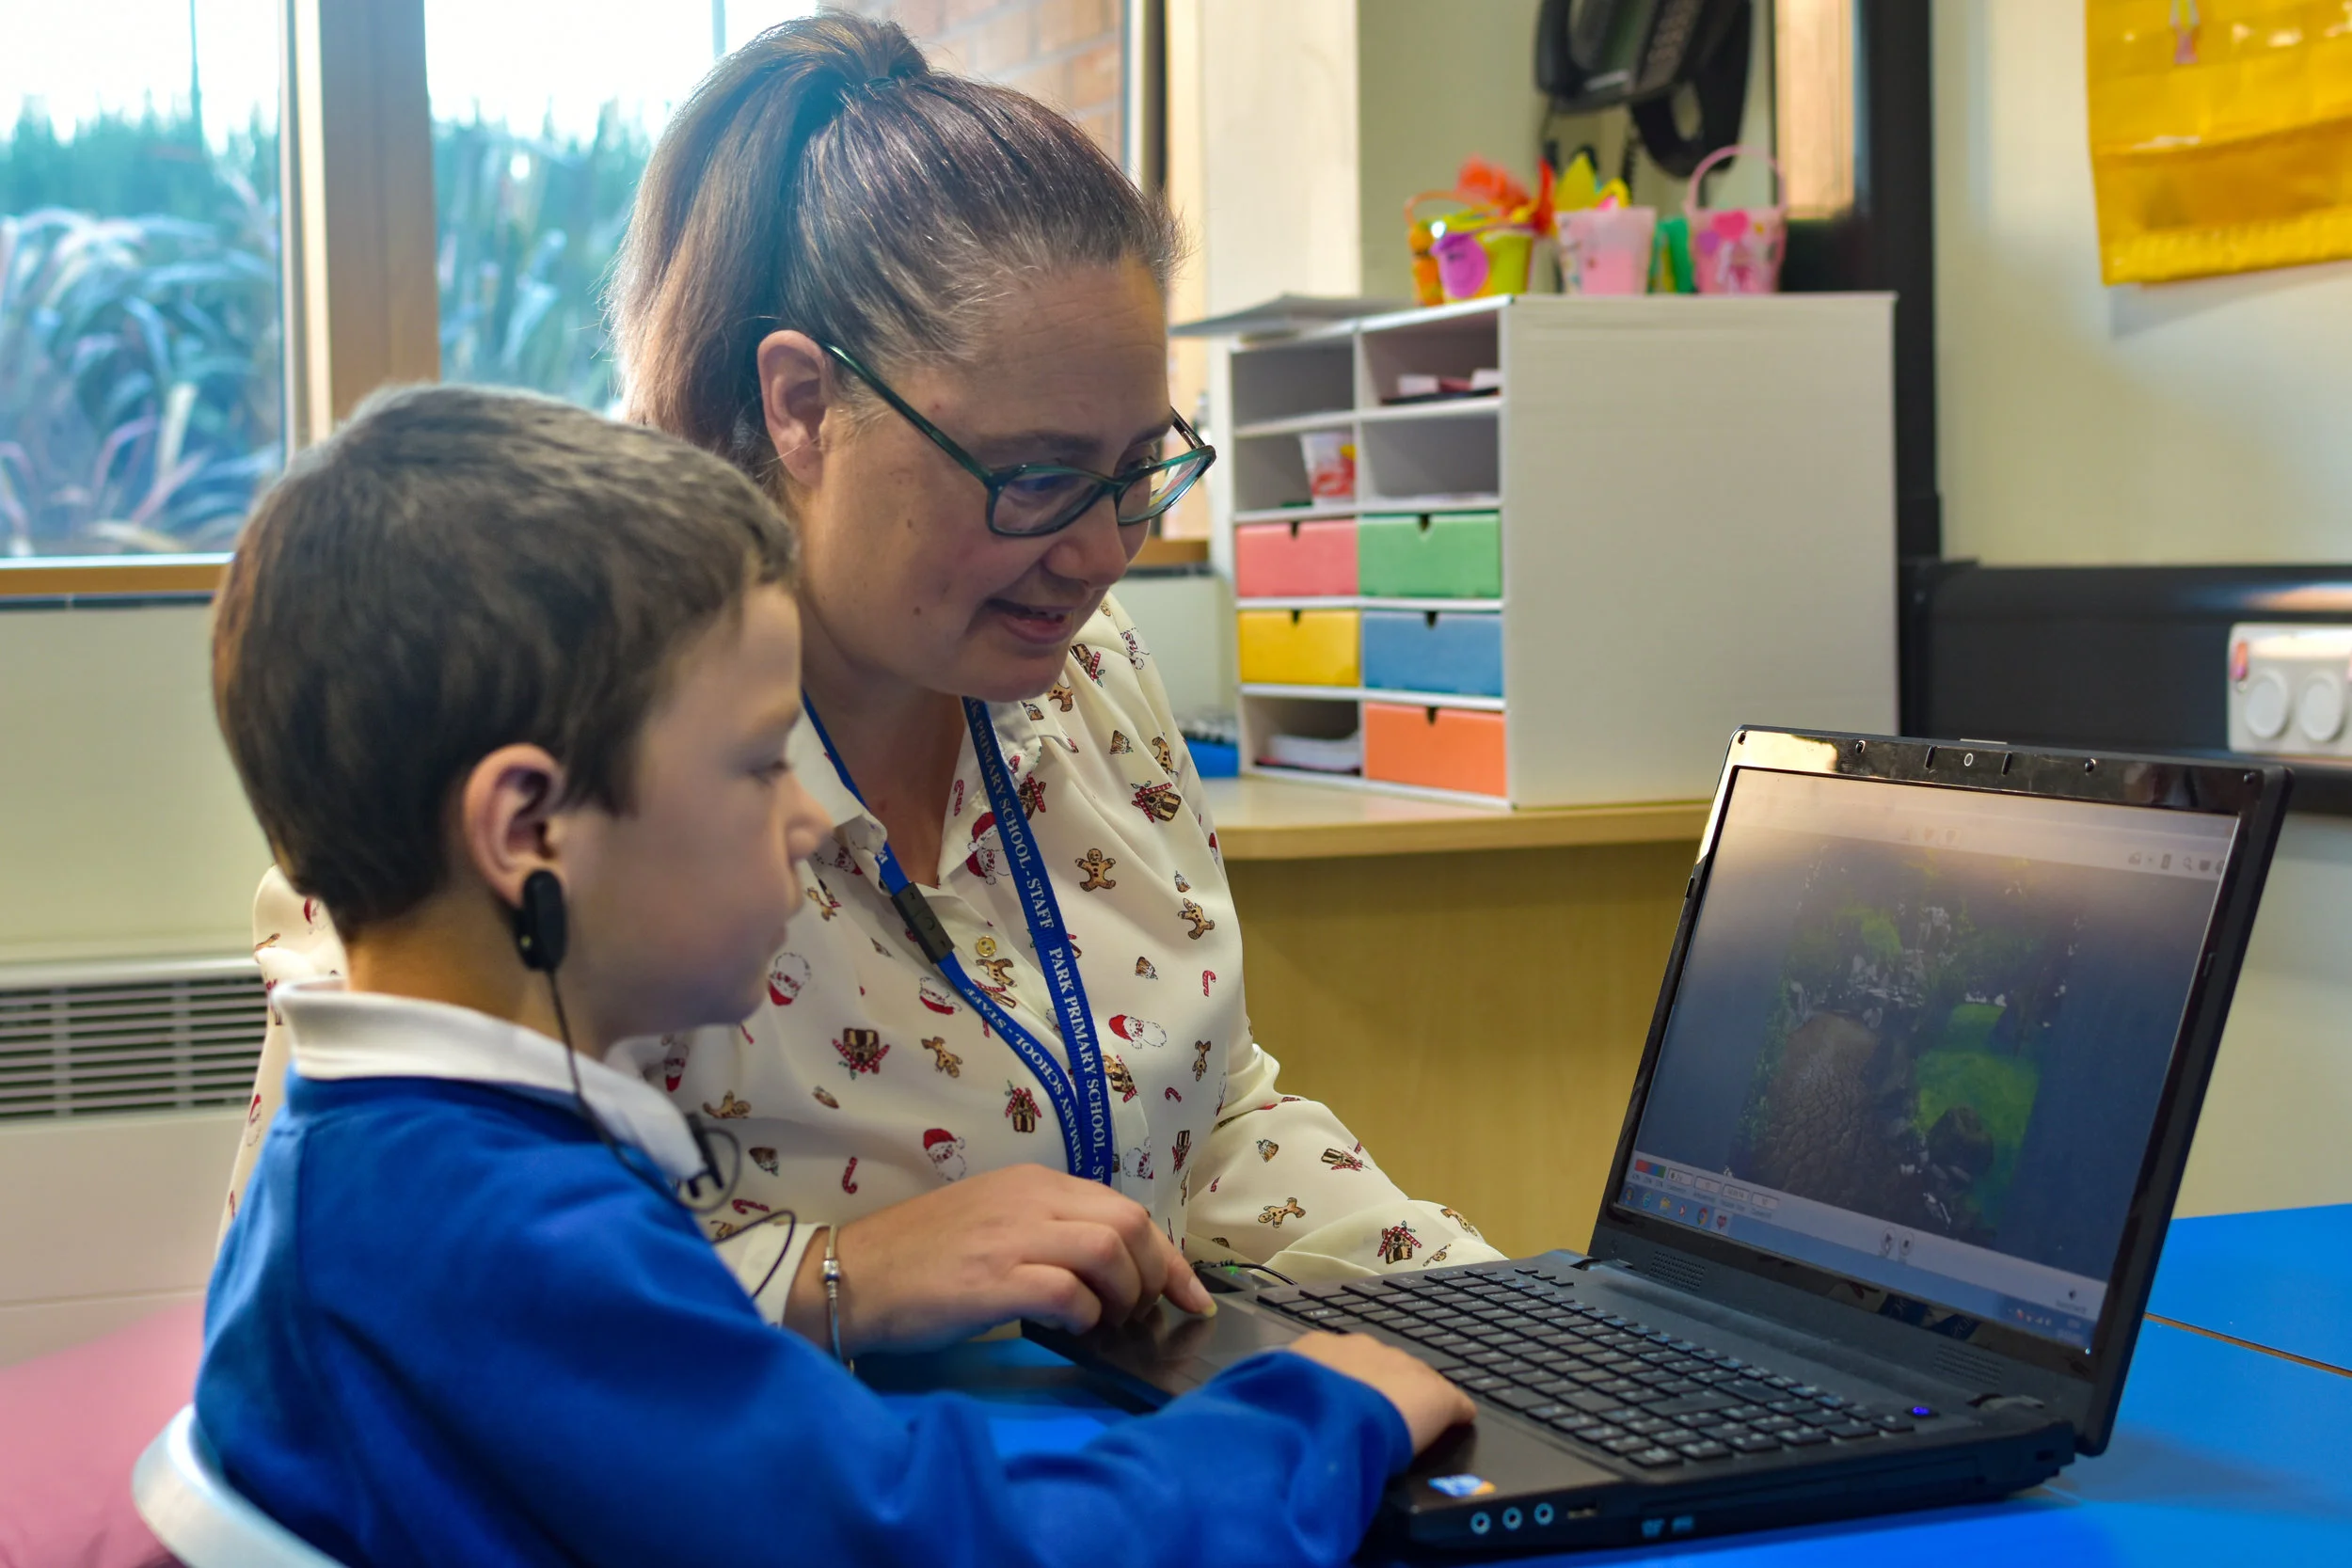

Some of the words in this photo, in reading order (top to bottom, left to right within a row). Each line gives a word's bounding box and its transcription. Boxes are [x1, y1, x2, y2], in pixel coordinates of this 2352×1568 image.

[975, 720, 1007, 797] PRIMARY
[999, 799, 1032, 869] SCHOOL
[1026, 878, 1055, 929] STAFF
[964, 988, 1006, 1028] STAFF
[1015, 1033, 1064, 1097] SCHOOL
[1049, 947, 1073, 995] PARK
[1064, 997, 1096, 1075] PRIMARY
[1087, 1080, 1106, 1152] SCHOOL
[1059, 1097, 1082, 1172] PRIMARY
